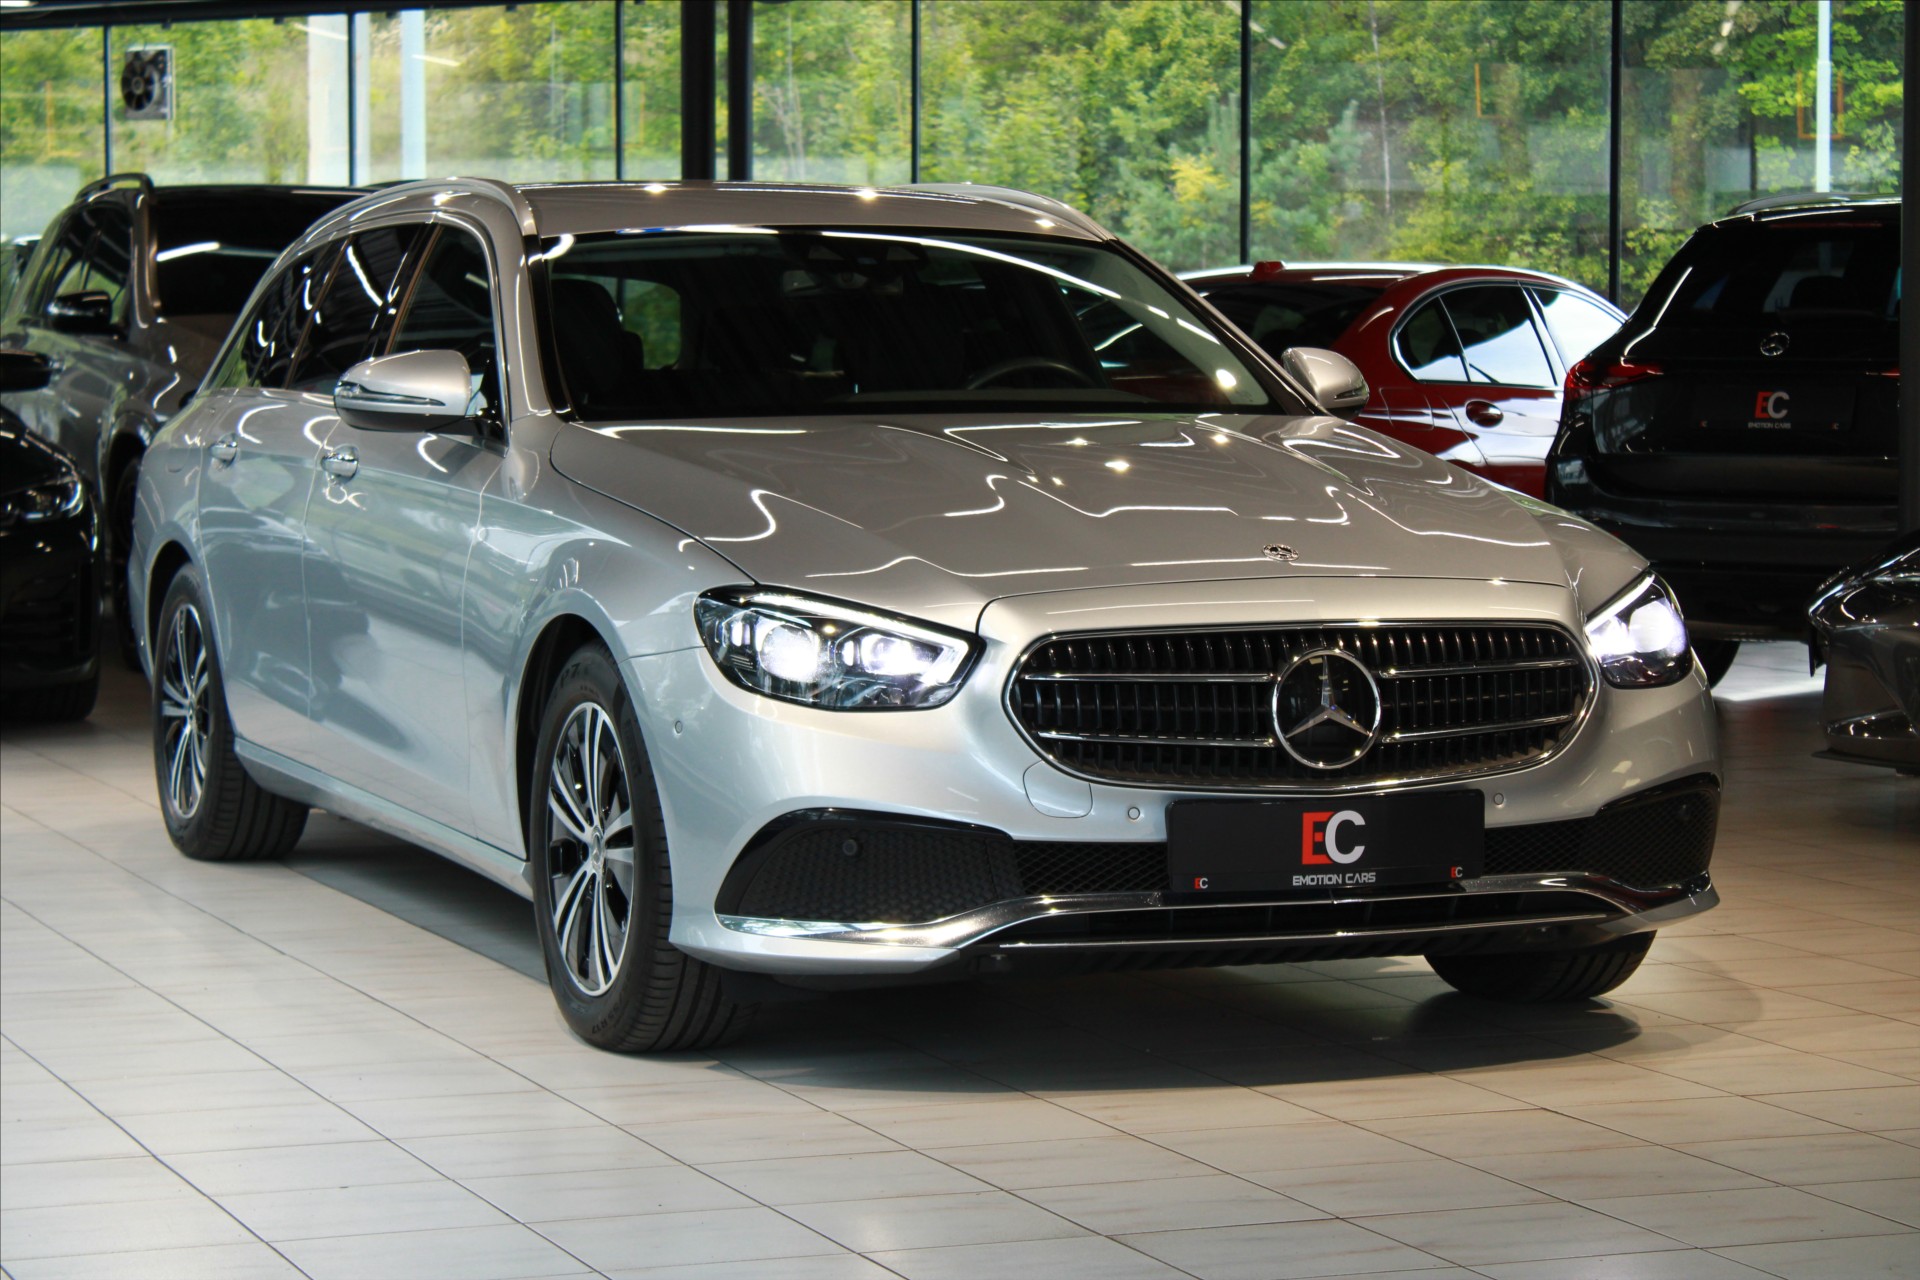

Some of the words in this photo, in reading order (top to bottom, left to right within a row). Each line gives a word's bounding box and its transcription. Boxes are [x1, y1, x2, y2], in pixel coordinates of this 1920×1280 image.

[1754, 391, 1790, 419] EC
[1302, 810, 1366, 865] EC
[1194, 877, 1208, 889] EC
[1293, 874, 1342, 886] EMOTION
[1345, 872, 1376, 884] CARS
